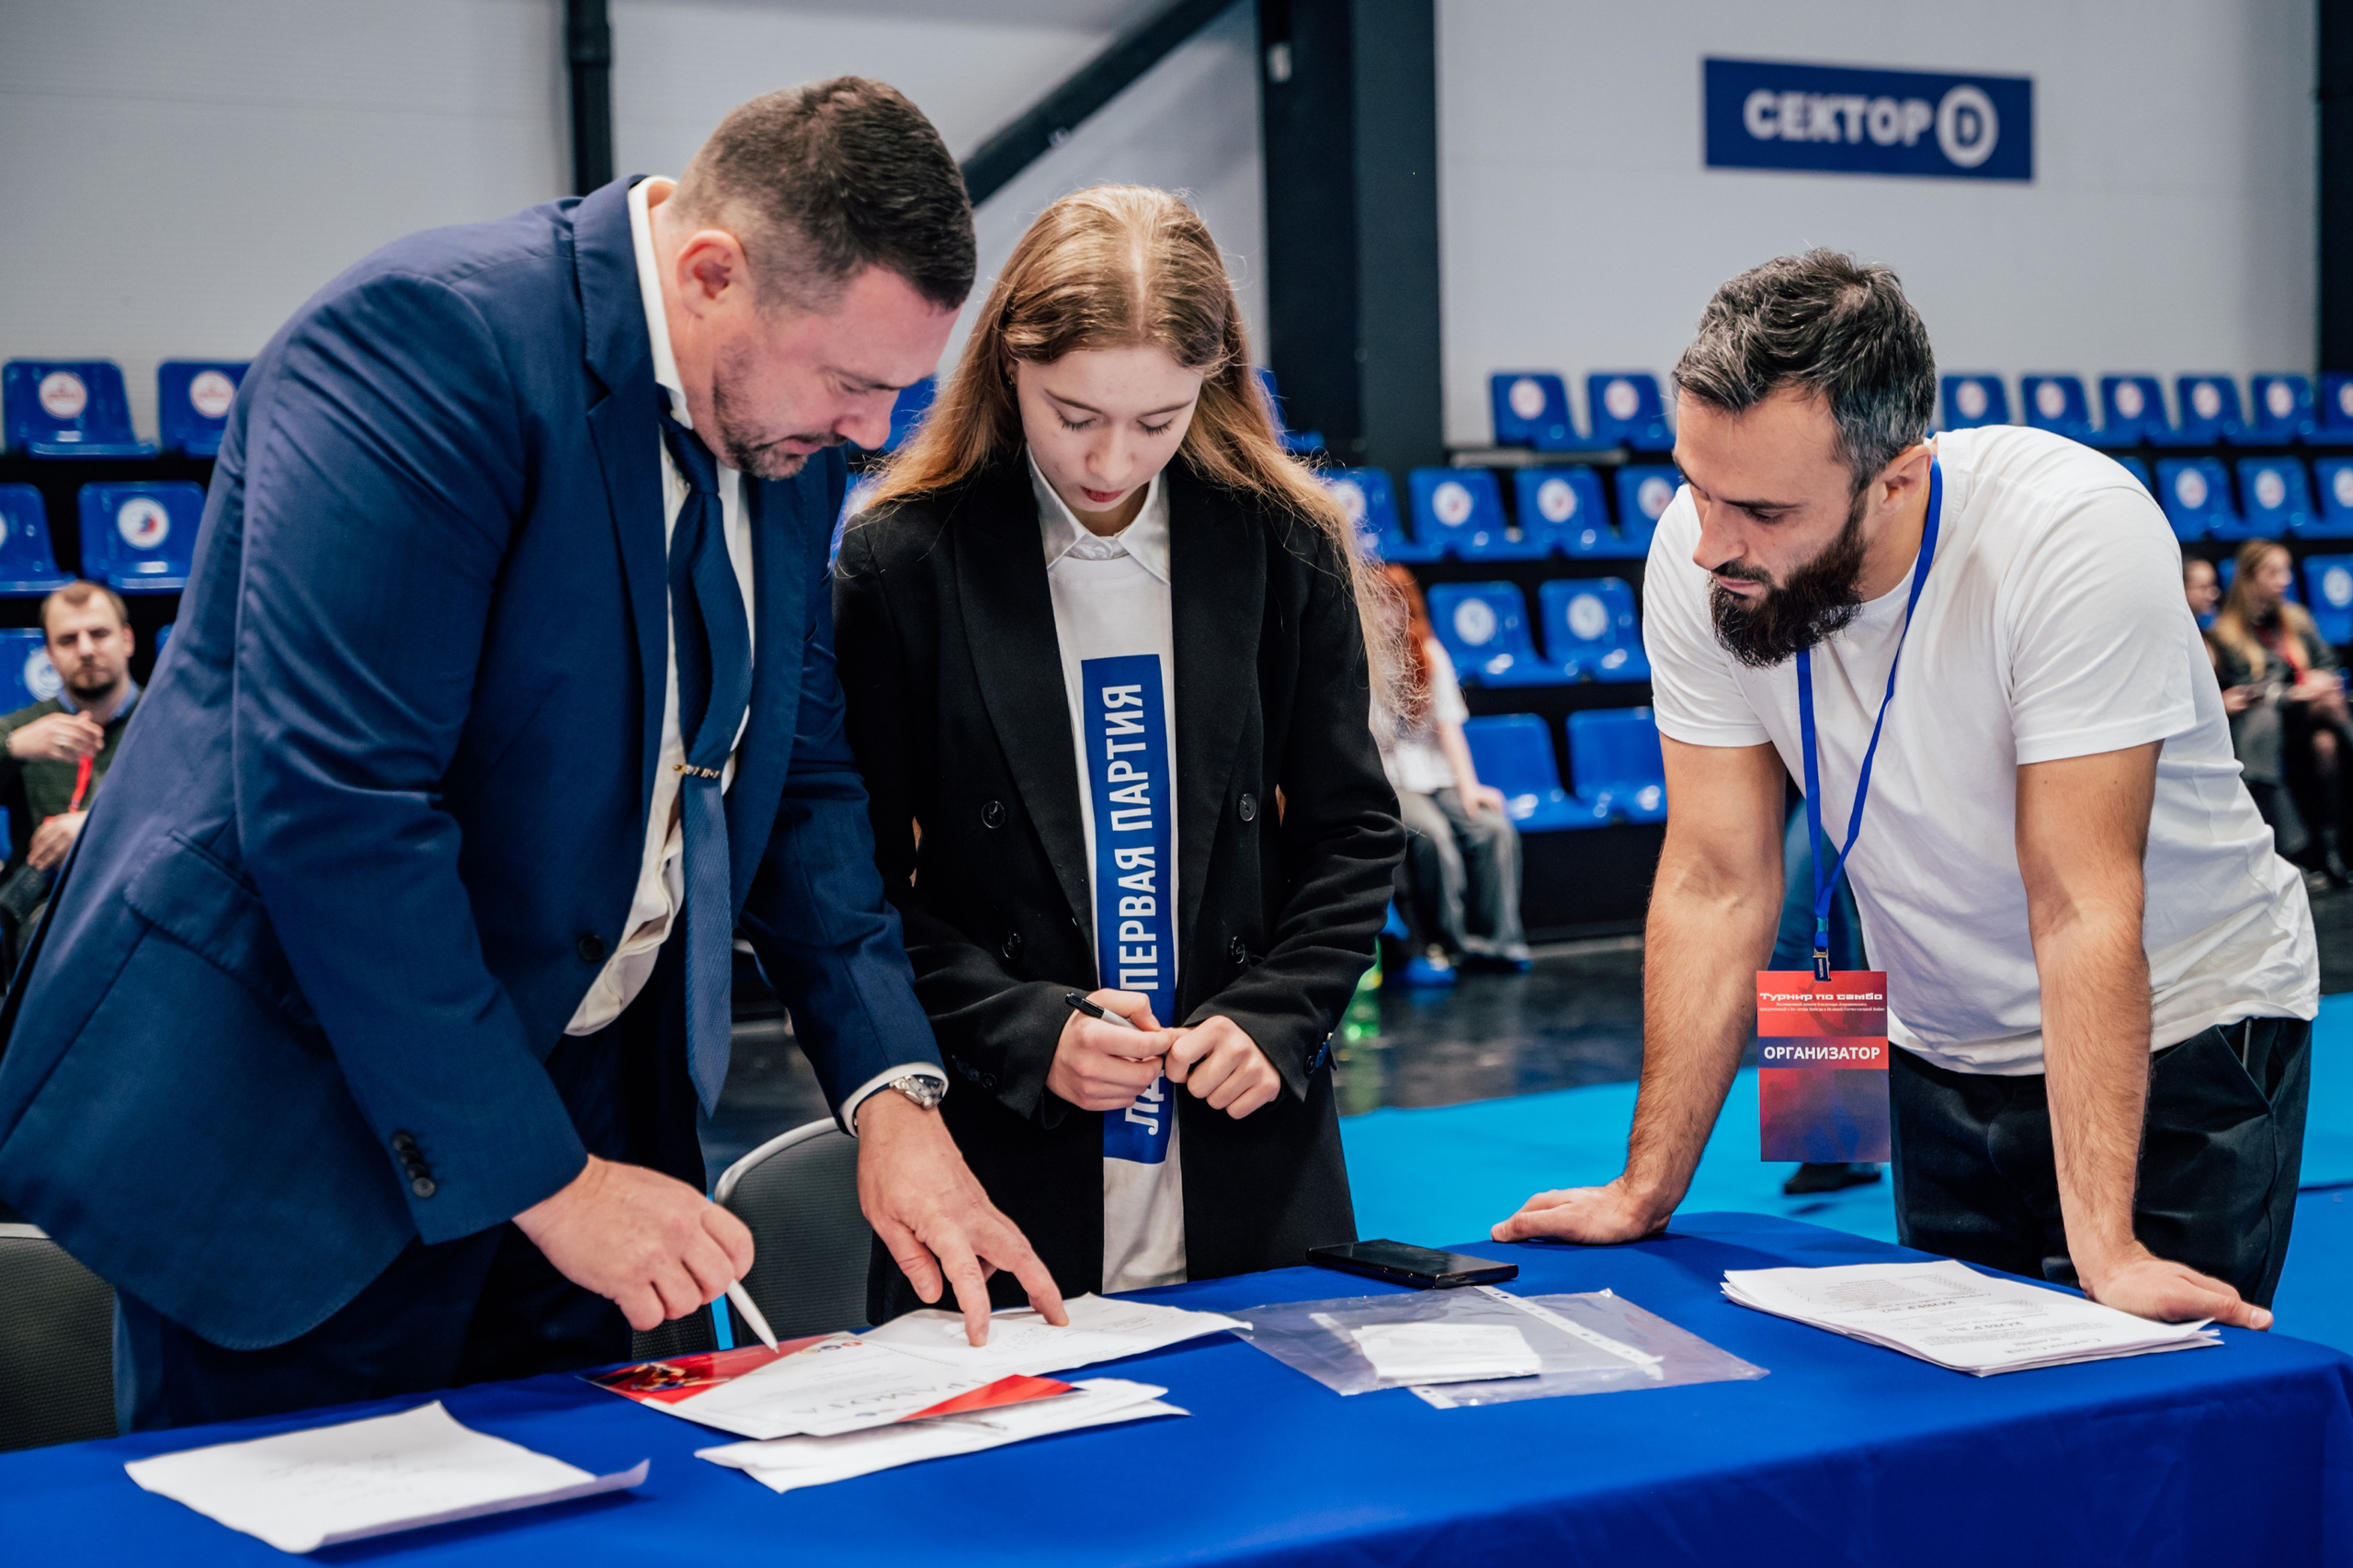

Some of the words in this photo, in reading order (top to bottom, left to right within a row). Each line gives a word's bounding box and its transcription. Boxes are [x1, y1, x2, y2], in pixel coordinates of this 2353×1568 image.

[1743, 87, 1934, 147] СЕКТОР
[1101, 683, 1154, 832] ПАРТИЯ
[1114, 846, 1158, 991] ПЕРВАЯ
[1759, 993, 1813, 1001] Турнир
[1764, 1046, 1881, 1060] ОРГАНИЗАТОР
